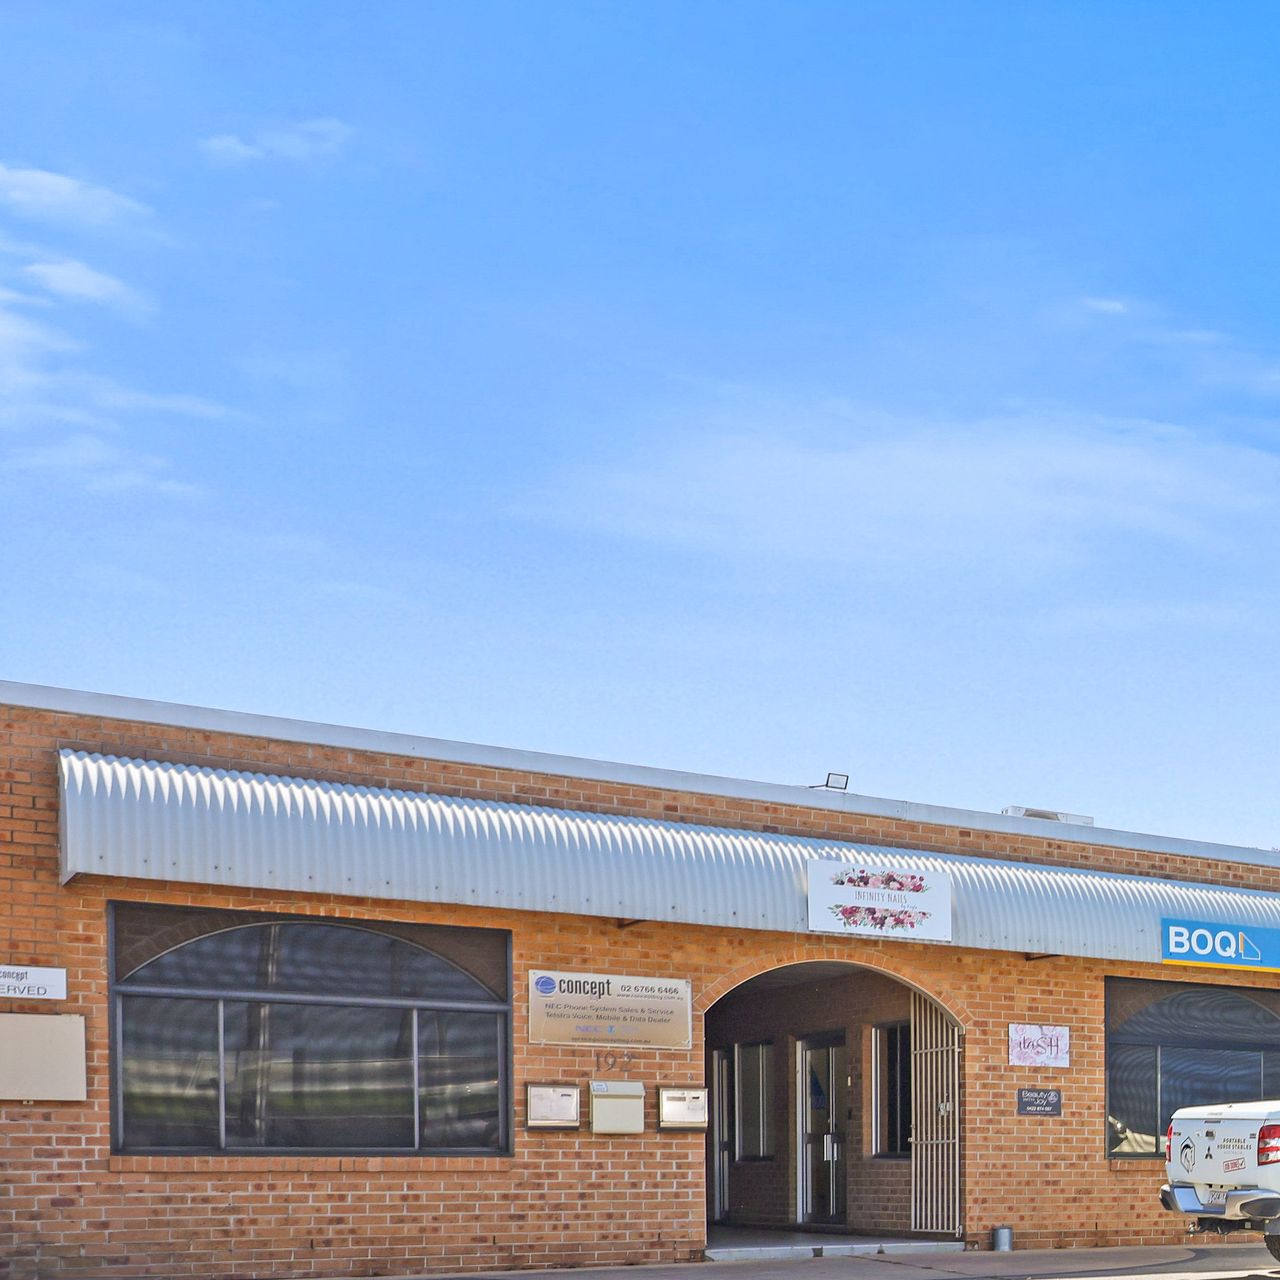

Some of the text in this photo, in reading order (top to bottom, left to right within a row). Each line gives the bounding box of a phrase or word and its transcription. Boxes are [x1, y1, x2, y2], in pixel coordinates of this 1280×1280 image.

[854, 891, 908, 904] INFINITY NAILS
[1168, 925, 1237, 958] BOQ
[558, 978, 612, 999] concept
[620, 984, 680, 995] 02 6766 6466
[563, 1003, 588, 1011] Phone
[589, 1004, 617, 1013] System
[618, 1006, 638, 1014] Sales
[647, 1007, 675, 1016] Service
[545, 1011, 571, 1019] Telstra
[647, 1016, 671, 1024] Dealer
[595, 1052, 633, 1073] 192
[1022, 1090, 1048, 1100] Beauty
